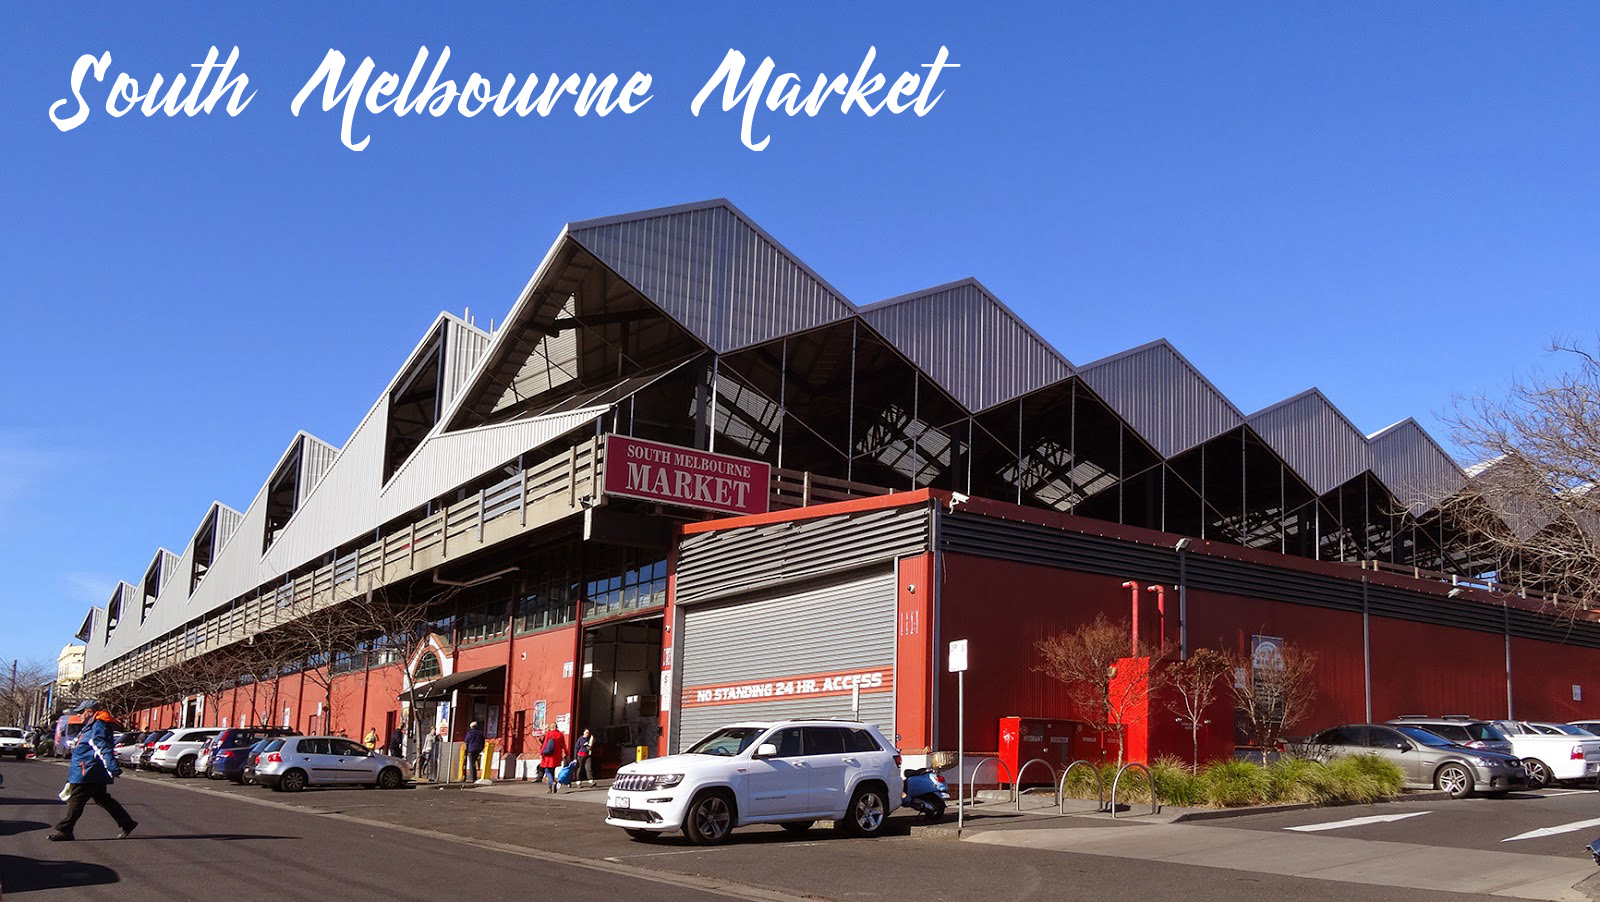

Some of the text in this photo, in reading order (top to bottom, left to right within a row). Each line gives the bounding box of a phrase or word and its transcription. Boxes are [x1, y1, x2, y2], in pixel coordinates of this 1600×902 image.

[627, 444, 751, 479] SOUTH MELBOURNE
[625, 462, 751, 509] MARKET
[697, 689, 713, 702] NO
[714, 683, 773, 701] STANDING
[775, 681, 794, 696] 24
[796, 679, 819, 694] HR.
[822, 672, 883, 691] ACCESS
